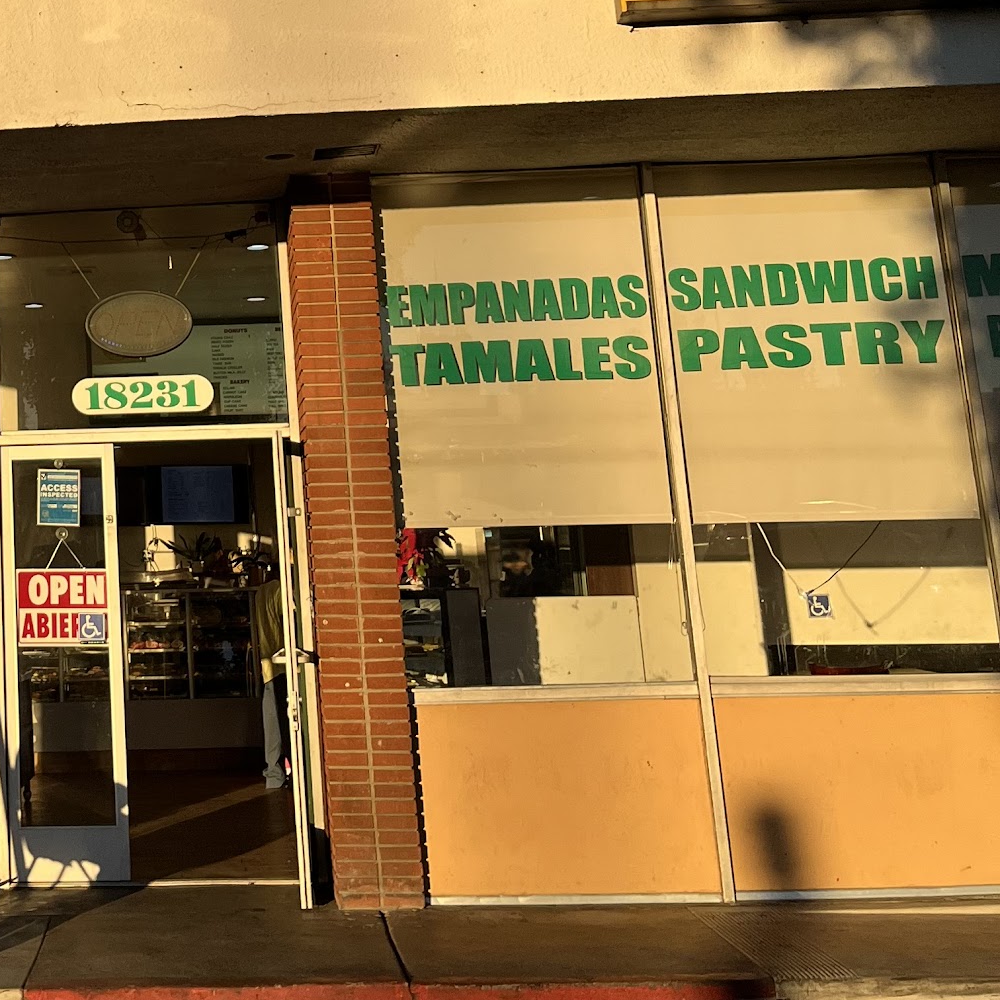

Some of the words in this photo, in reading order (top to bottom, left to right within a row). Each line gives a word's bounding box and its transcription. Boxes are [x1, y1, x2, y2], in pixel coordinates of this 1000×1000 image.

[387, 274, 648, 327] EMPANADAS
[668, 256, 940, 311] SANDWICH
[389, 335, 652, 386] TAMALES
[677, 319, 946, 372] PASTRY
[85, 379, 201, 410] 18231
[40, 483, 78, 492] ACCESS
[28, 574, 105, 606] OPEN
